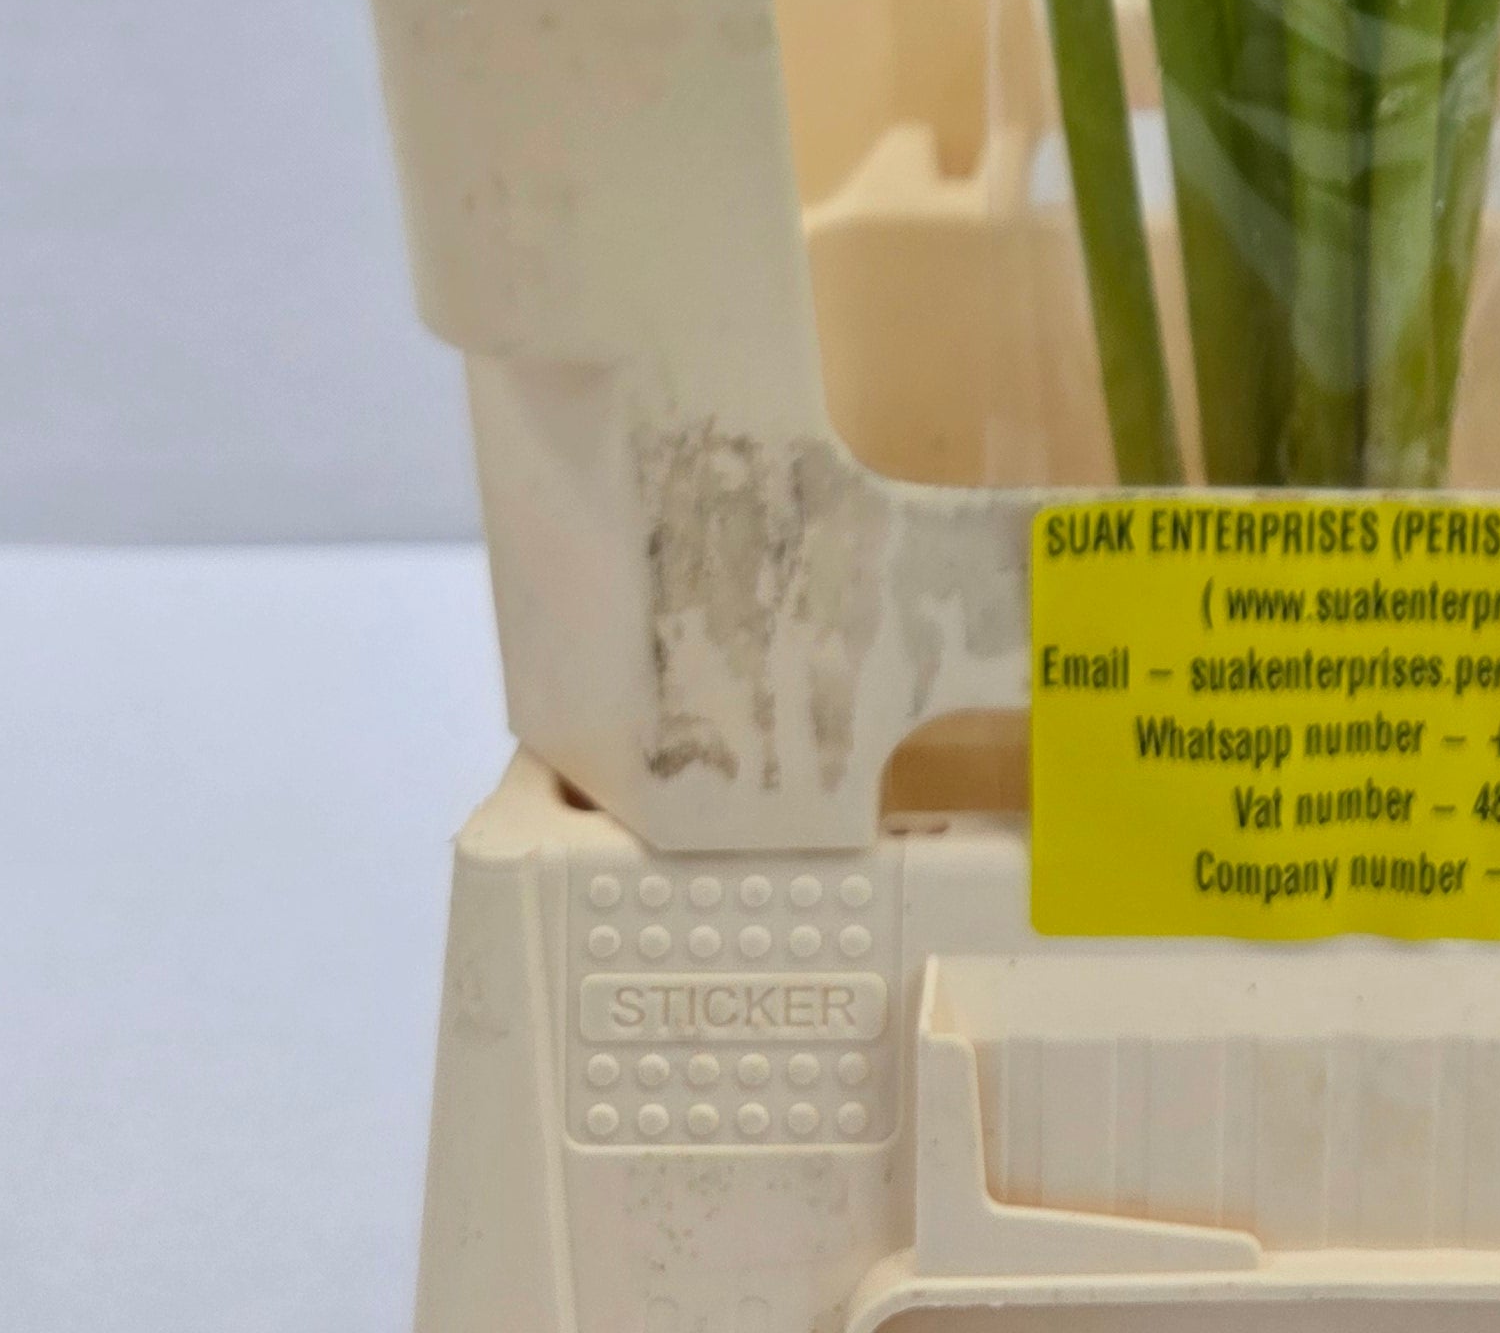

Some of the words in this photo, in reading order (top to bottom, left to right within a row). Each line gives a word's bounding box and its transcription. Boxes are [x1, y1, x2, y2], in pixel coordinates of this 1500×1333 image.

[1047, 511, 1133, 558] SUAK
[1150, 510, 1378, 554] ENTERPRISES
[1040, 645, 1129, 689] Email
[1136, 717, 1291, 769] Whatsapp
[1305, 714, 1425, 756] number
[1234, 787, 1282, 830] Vat
[1296, 779, 1415, 826] number
[1194, 850, 1337, 904] Company
[1350, 853, 1467, 896] number
[611, 985, 857, 1028] STICKER
